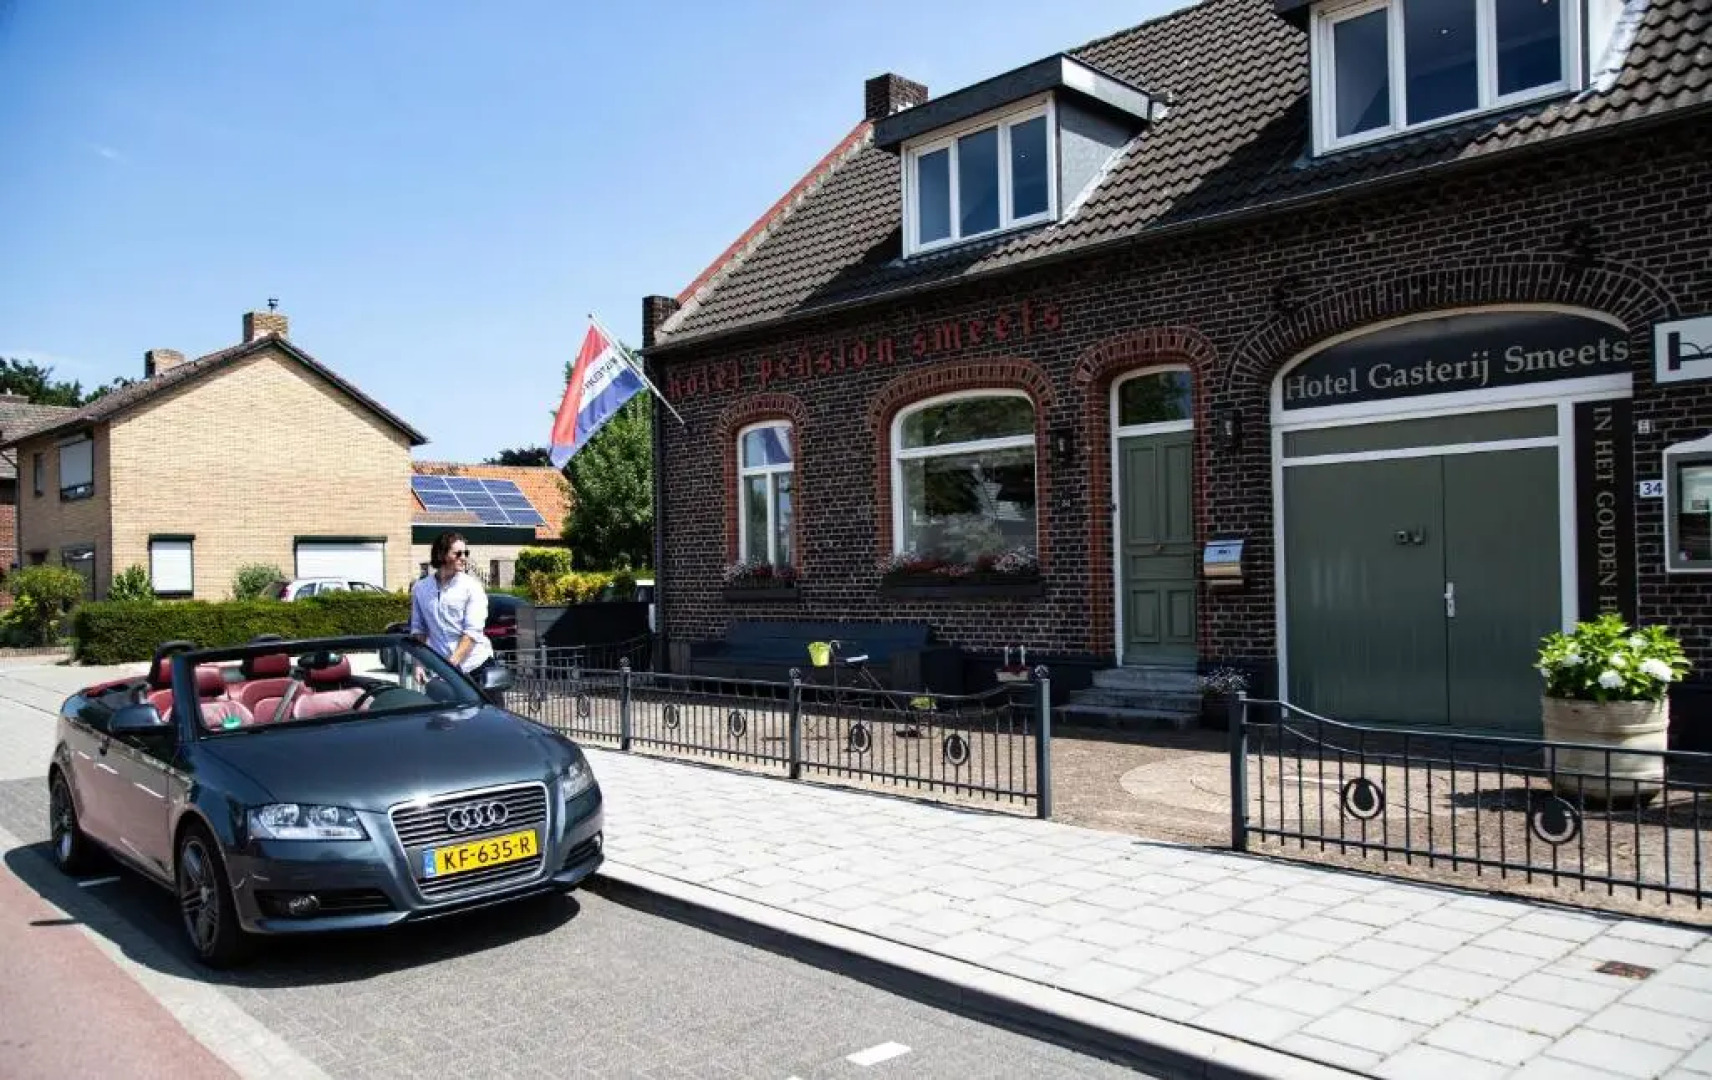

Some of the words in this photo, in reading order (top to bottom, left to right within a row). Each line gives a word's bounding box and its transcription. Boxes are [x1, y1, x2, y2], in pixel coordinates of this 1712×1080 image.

[1286, 367, 1358, 402] Hotel
[1368, 350, 1490, 387] Gasterij
[1504, 337, 1631, 375] Smeets
[1593, 406, 1613, 431] IN
[1594, 440, 1615, 484] HET
[1642, 481, 1662, 496] 34
[1596, 492, 1618, 587] GOUDEN
[443, 836, 530, 870] KF-635-R
